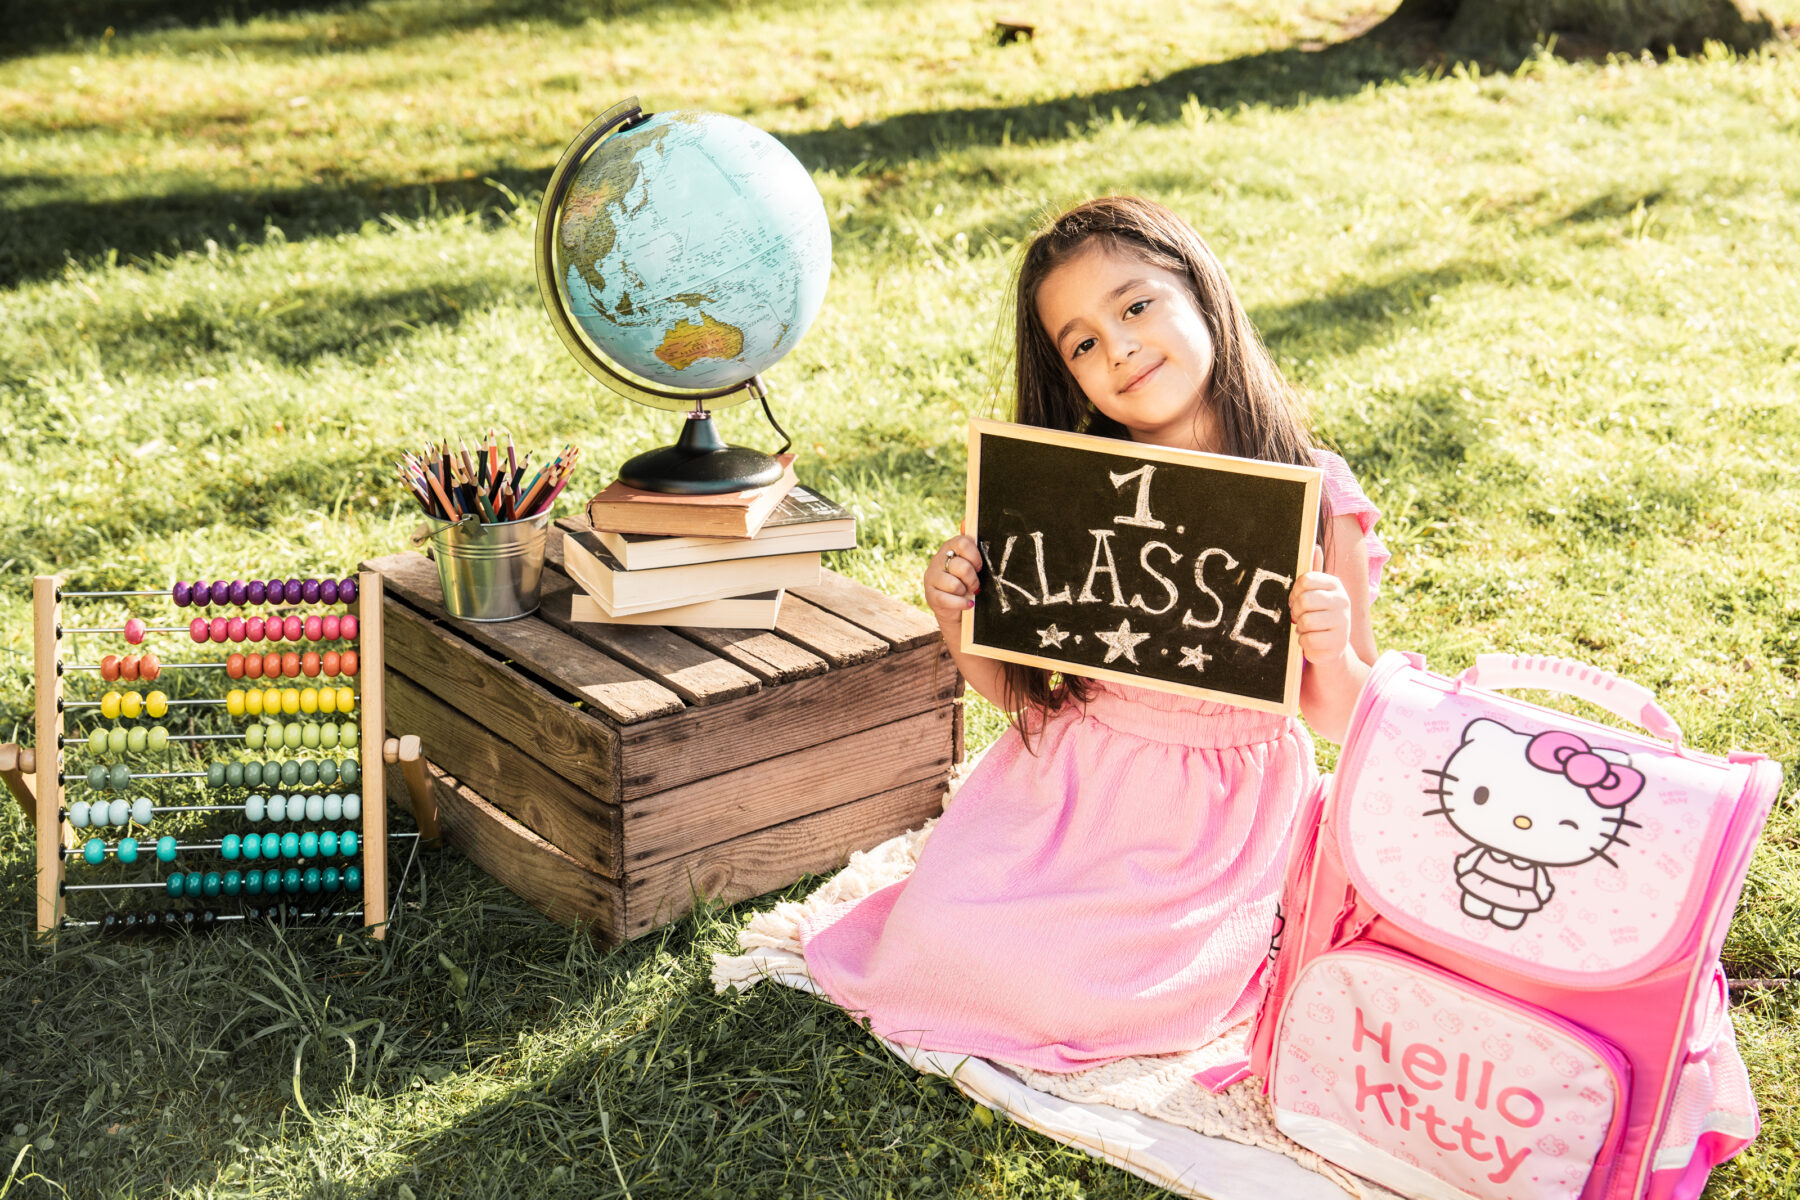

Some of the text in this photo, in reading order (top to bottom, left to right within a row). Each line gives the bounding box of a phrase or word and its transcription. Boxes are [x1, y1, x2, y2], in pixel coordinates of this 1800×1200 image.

[1109, 464, 1185, 534] 1.
[979, 529, 1293, 657] KLASSE
[1352, 1006, 1545, 1128] Hello
[1355, 1064, 1532, 1184] Kitty
